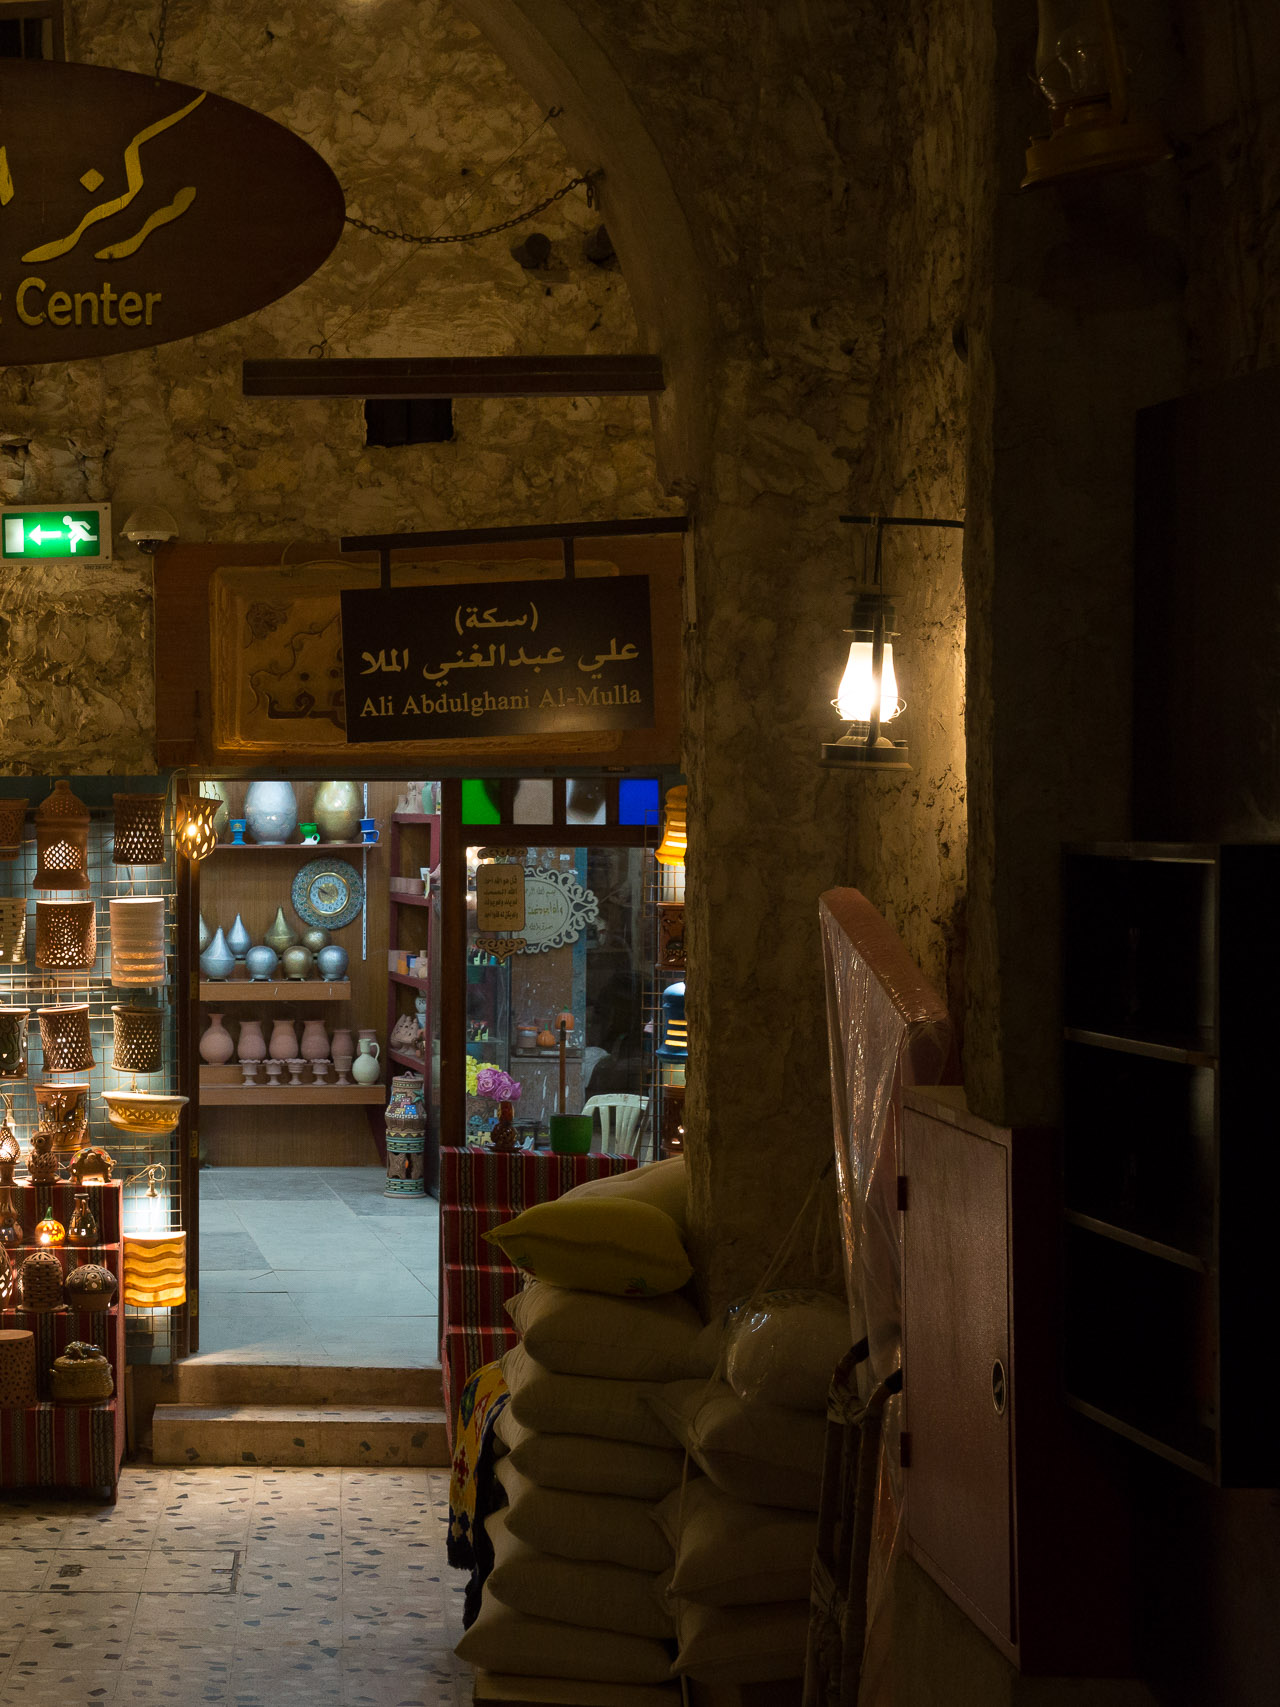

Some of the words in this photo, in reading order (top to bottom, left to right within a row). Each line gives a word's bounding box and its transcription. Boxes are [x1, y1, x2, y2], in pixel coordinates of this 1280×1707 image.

[21, 90, 208, 263] مركز
[16, 276, 162, 329] Center
[454, 601, 539, 635] (سكة)
[359, 648, 409, 675] الملا
[577, 636, 639, 679] علي
[359, 696, 394, 717] Ali
[402, 688, 530, 717] Abdulghani
[538, 684, 642, 709] Al-Mulla
